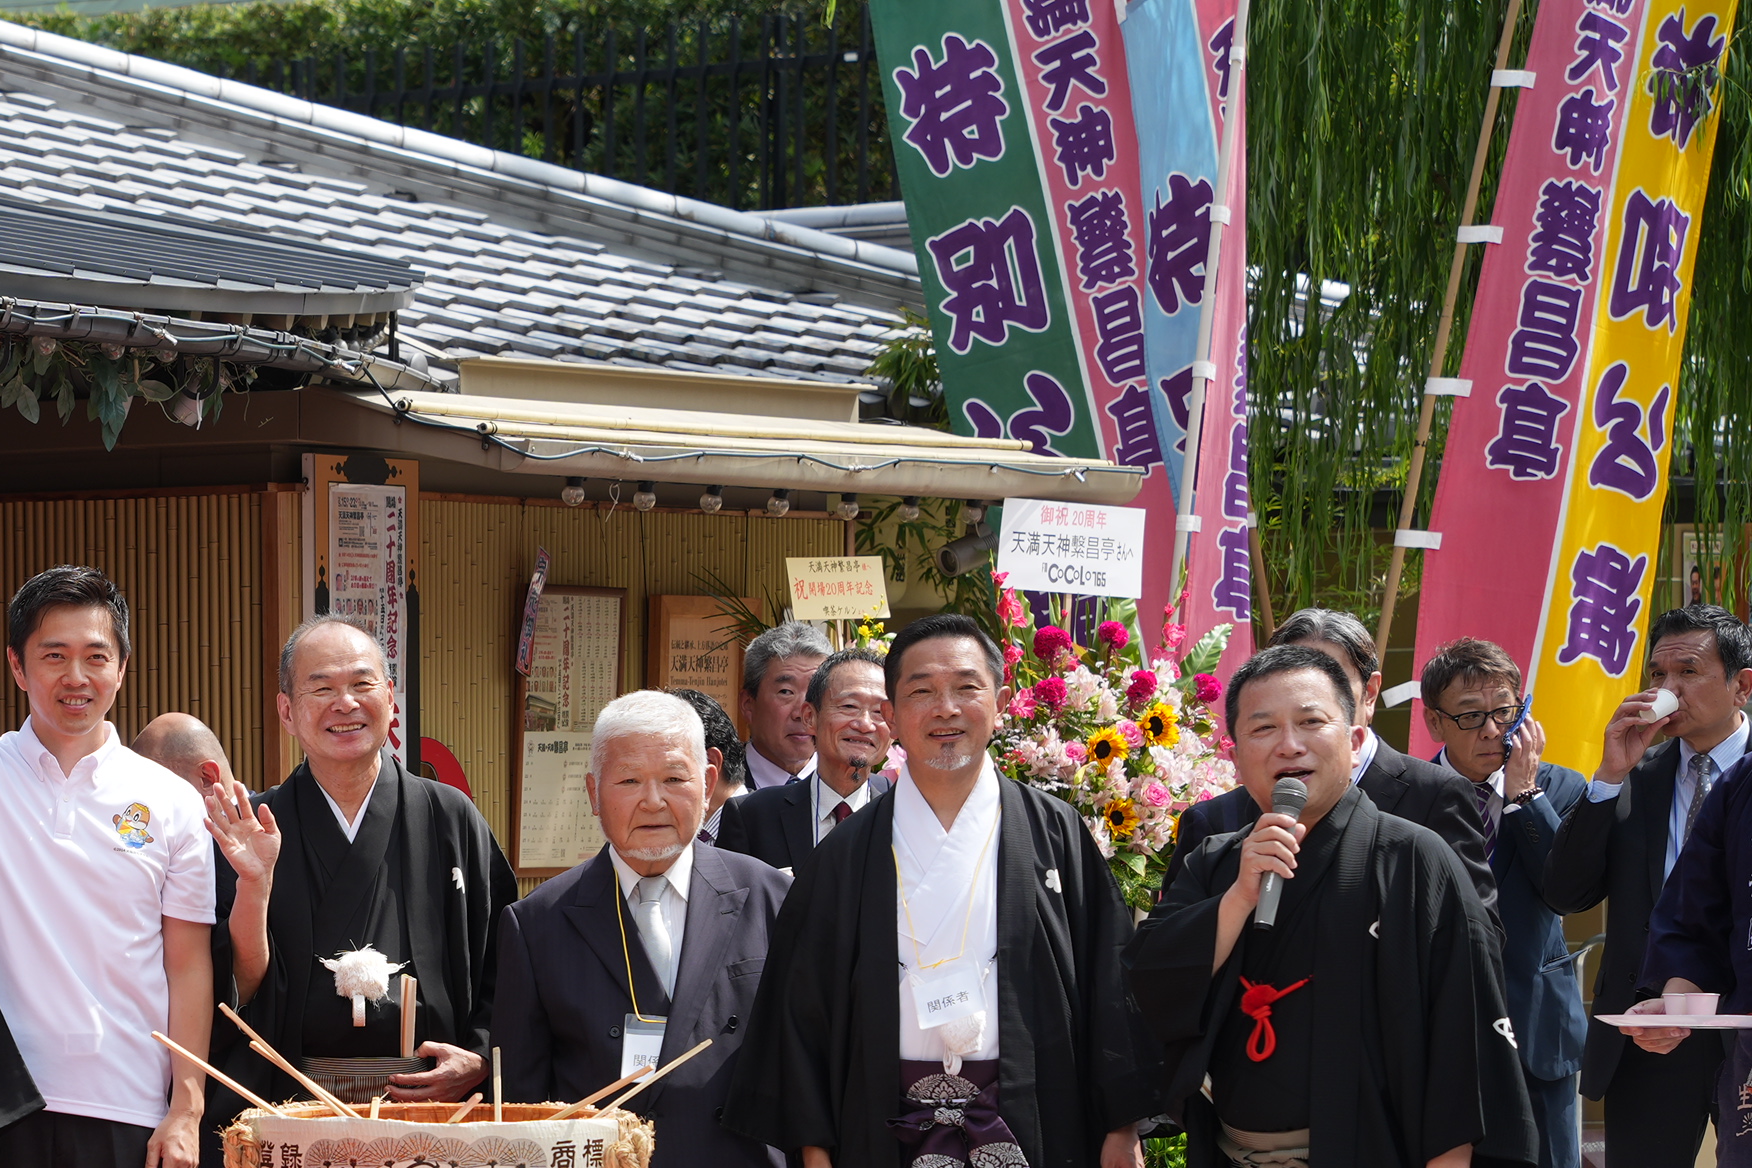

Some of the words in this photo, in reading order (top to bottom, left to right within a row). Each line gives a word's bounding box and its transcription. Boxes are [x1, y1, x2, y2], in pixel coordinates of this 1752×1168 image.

[1041, 505, 1068, 526] 御祝
[1072, 509, 1107, 529] 20周年
[926, 990, 970, 1014] 関係者
[550, 1138, 604, 1168] 商標
